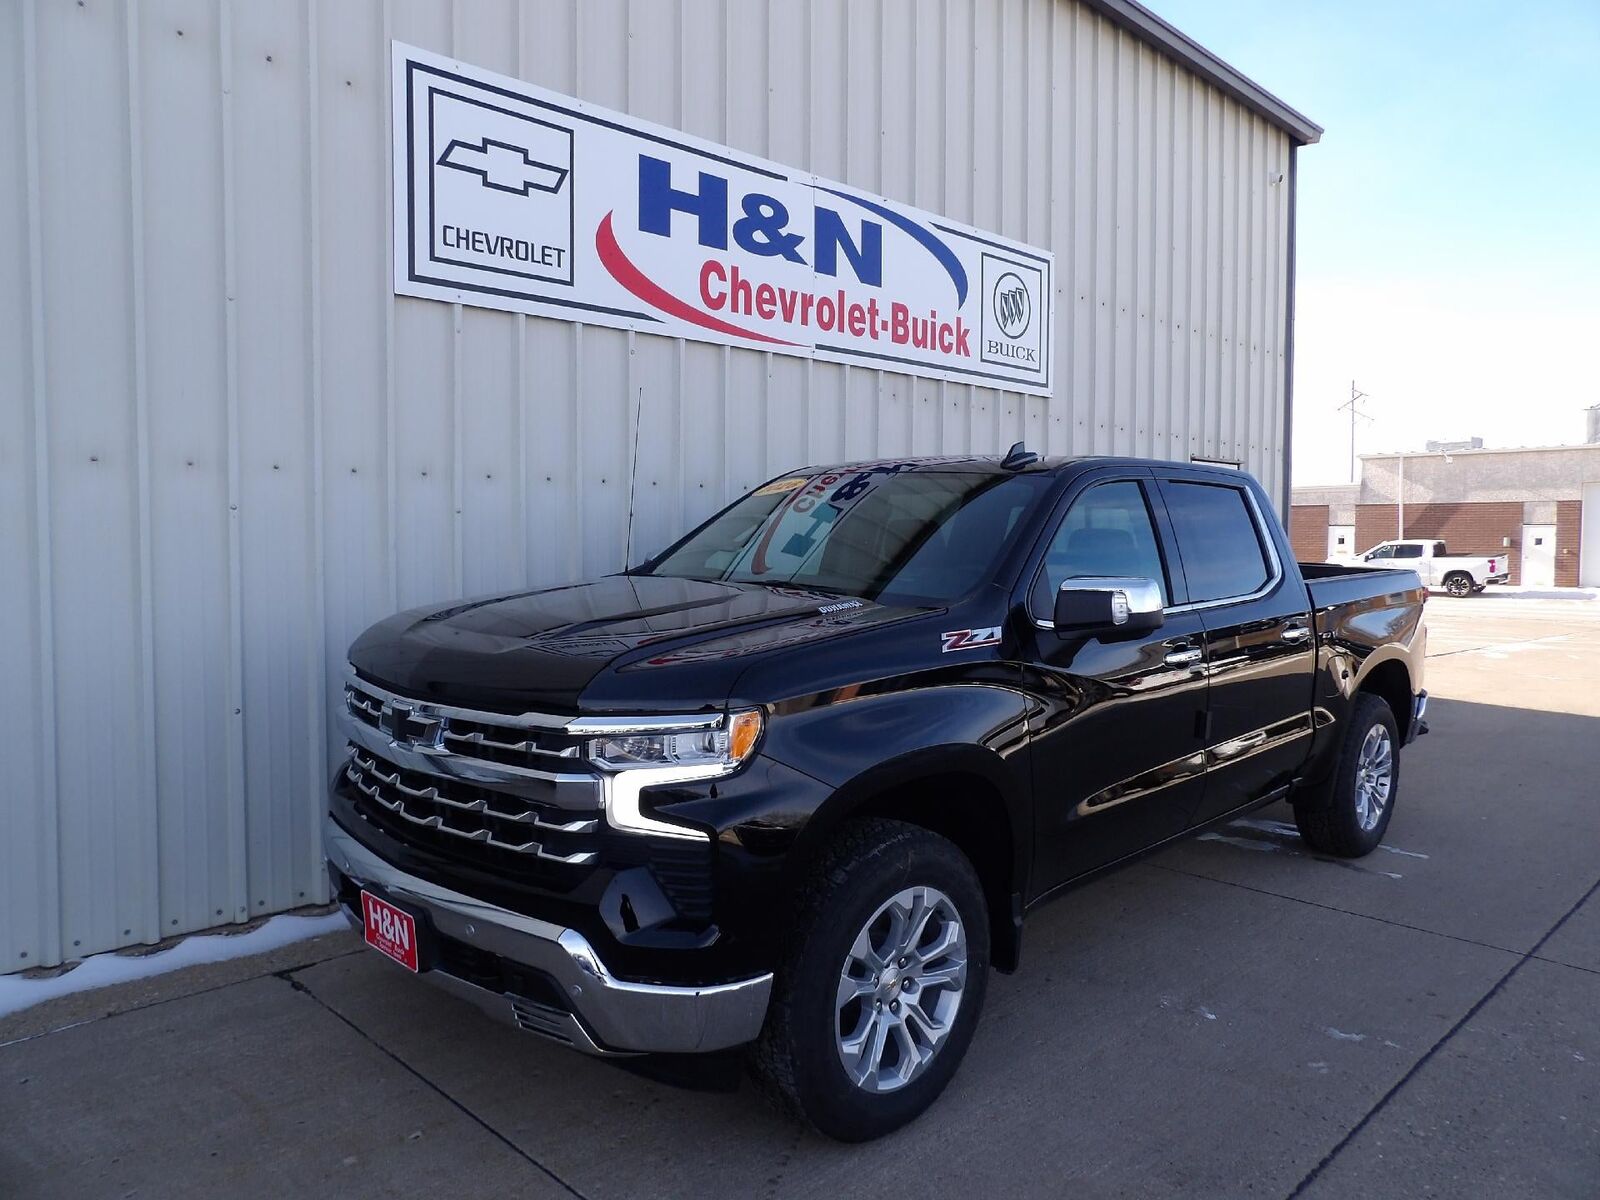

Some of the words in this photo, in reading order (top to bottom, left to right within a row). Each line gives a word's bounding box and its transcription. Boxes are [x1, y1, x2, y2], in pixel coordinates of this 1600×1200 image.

[638, 153, 882, 288] H&N
[442, 224, 566, 268] CHEVROLET
[699, 259, 971, 358] Chevrolet-Buick
[987, 339, 1036, 362] BUICK
[941, 626, 1002, 653] Z71
[368, 900, 410, 951] H&N
